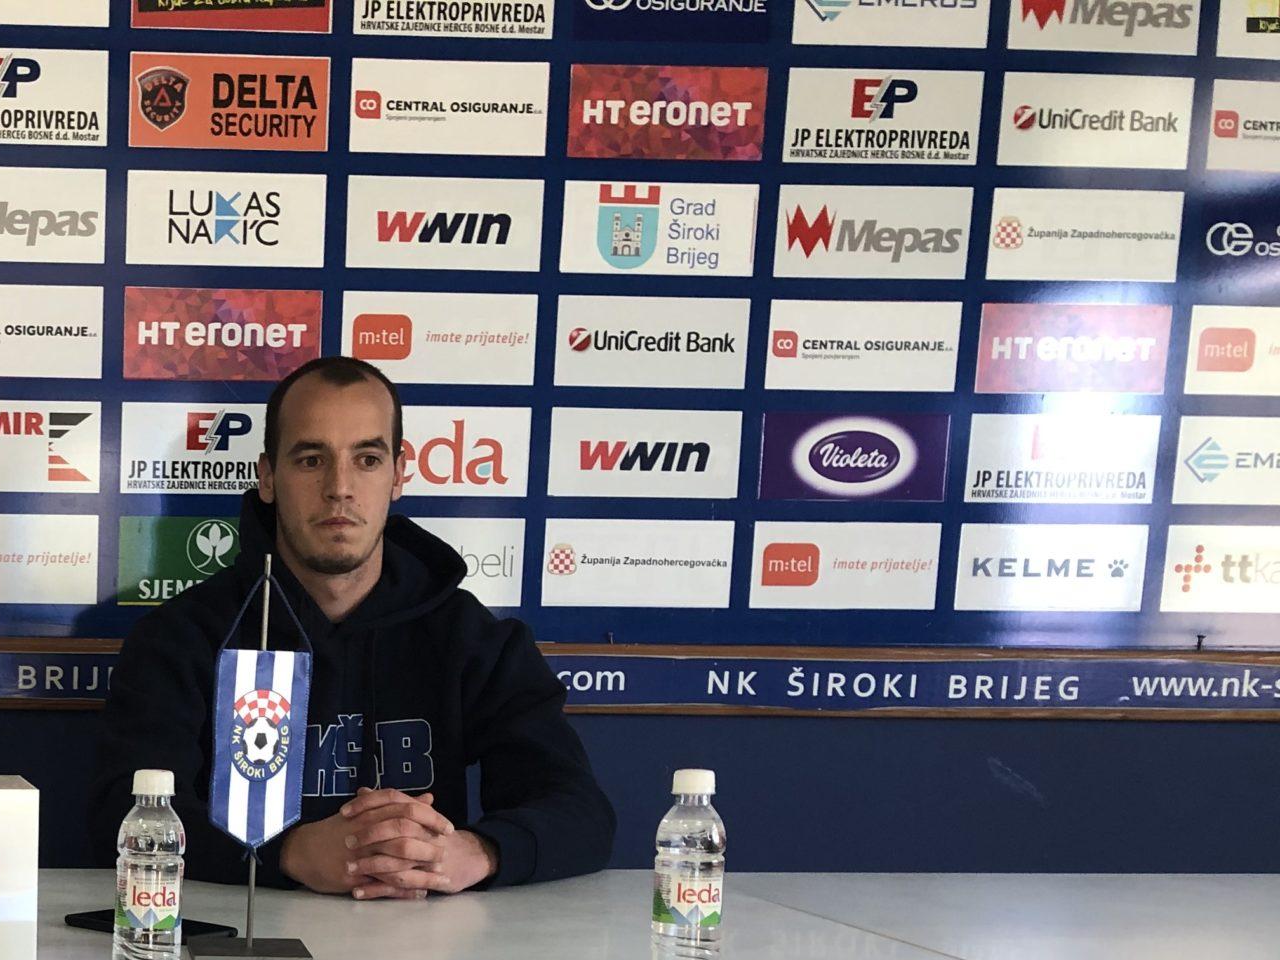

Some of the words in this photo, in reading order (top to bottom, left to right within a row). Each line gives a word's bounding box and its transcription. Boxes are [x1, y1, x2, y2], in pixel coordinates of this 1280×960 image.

[362, 0, 382, 20] JP
[387, 0, 545, 23] ELEKTROPRIVREDA
[212, 73, 316, 109] DELTA
[386, 101, 447, 112] CENTRAL
[450, 102, 533, 114] OSIGURANJE
[583, 100, 624, 124] HT
[211, 113, 316, 138] SECURITY
[1039, 108, 1124, 130] UniCredit
[1130, 110, 1177, 132] Bank
[28, 131, 53, 140] BOSNE
[55, 131, 71, 140] d.d.
[73, 132, 99, 141] Mostar
[792, 129, 811, 148] JP
[816, 129, 970, 150] ELEKTROPRIVREDA
[670, 198, 715, 216] Grad
[669, 219, 720, 240] Široki
[1028, 228, 1068, 239] Županija
[836, 220, 962, 262] Mepas
[667, 248, 719, 269] Brijeg
[4, 325, 88, 337] OSIGURANJE
[138, 321, 180, 345] HT
[359, 329, 404, 345] m:tel
[425, 330, 461, 344] imate
[464, 331, 529, 346] prijatelje!
[594, 330, 681, 352] UniCredit
[687, 332, 734, 353] Bank
[802, 339, 860, 350] CENTRAL
[864, 341, 944, 352] OSIGURANJE
[1205, 341, 1248, 357] m:tel
[819, 442, 888, 469] Violeta
[129, 460, 147, 479] JP
[152, 461, 259, 480] ELEKTROPRIV
[973, 470, 991, 488] JP
[27, 551, 91, 566] prijatelje!
[581, 554, 620, 566] Županija
[624, 556, 727, 568] Zapadnohercegovačka
[769, 556, 811, 573] m:tel
[833, 558, 867, 571] imate
[871, 557, 932, 572] prijatelje!
[972, 558, 1095, 578] KELME
[707, 670, 757, 695] NK
[788, 667, 917, 697] ŠIROKI
[949, 674, 1080, 701] BRIJEG
[232, 725, 242, 744] NK
[269, 725, 289, 773] BRIJEG
[234, 751, 265, 778] ŠIROKI
[132, 885, 176, 907] leda
[676, 883, 720, 903] leda
